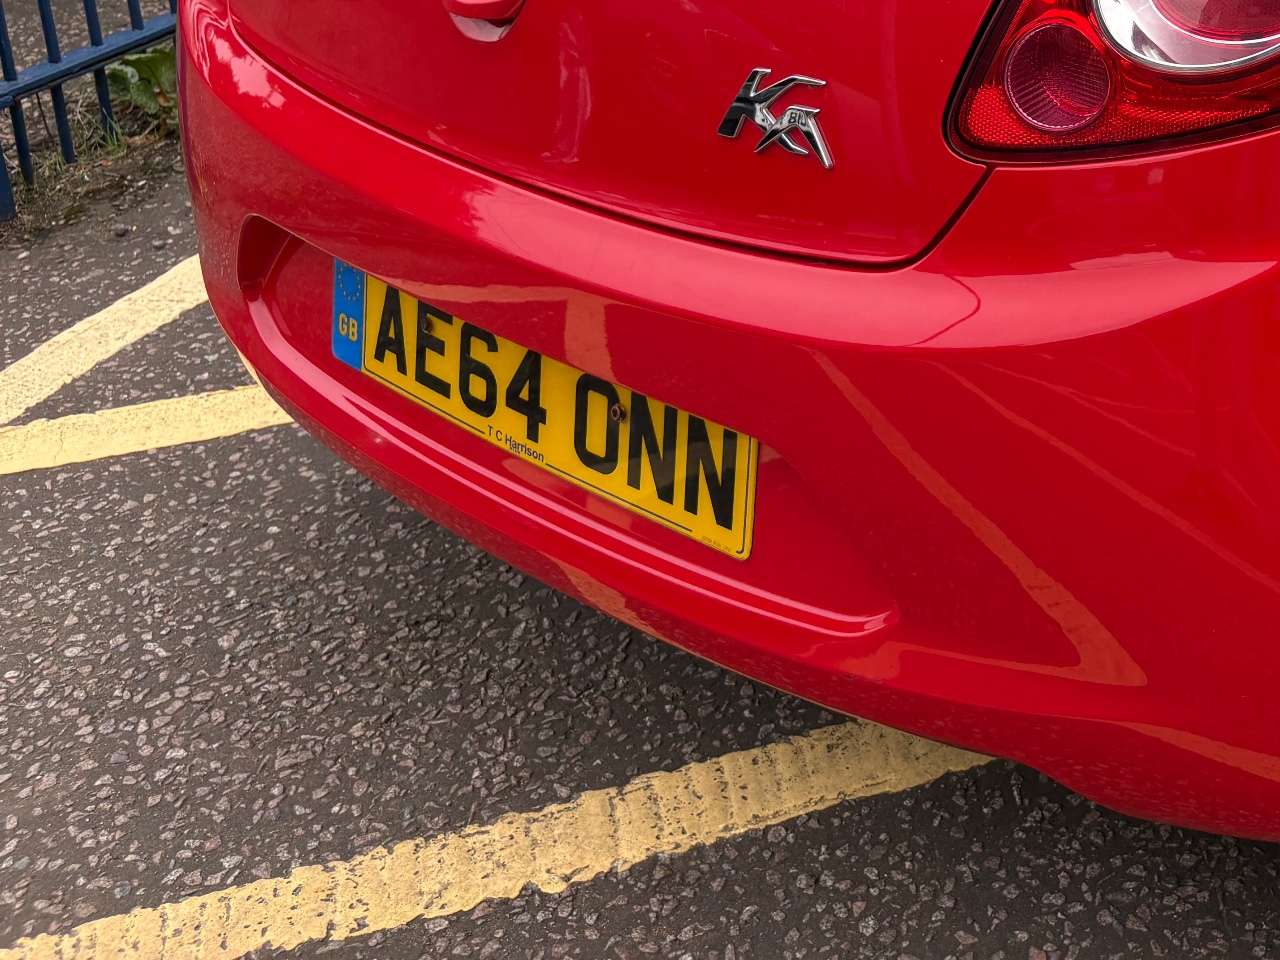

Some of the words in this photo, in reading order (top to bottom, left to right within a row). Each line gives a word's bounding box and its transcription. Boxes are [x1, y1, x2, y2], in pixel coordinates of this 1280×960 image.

[338, 312, 358, 342] GB
[373, 287, 548, 445] AE64
[573, 372, 738, 531] ONN
[487, 424, 494, 437] T
[495, 430, 503, 442] C
[505, 434, 545, 463] Harrison
